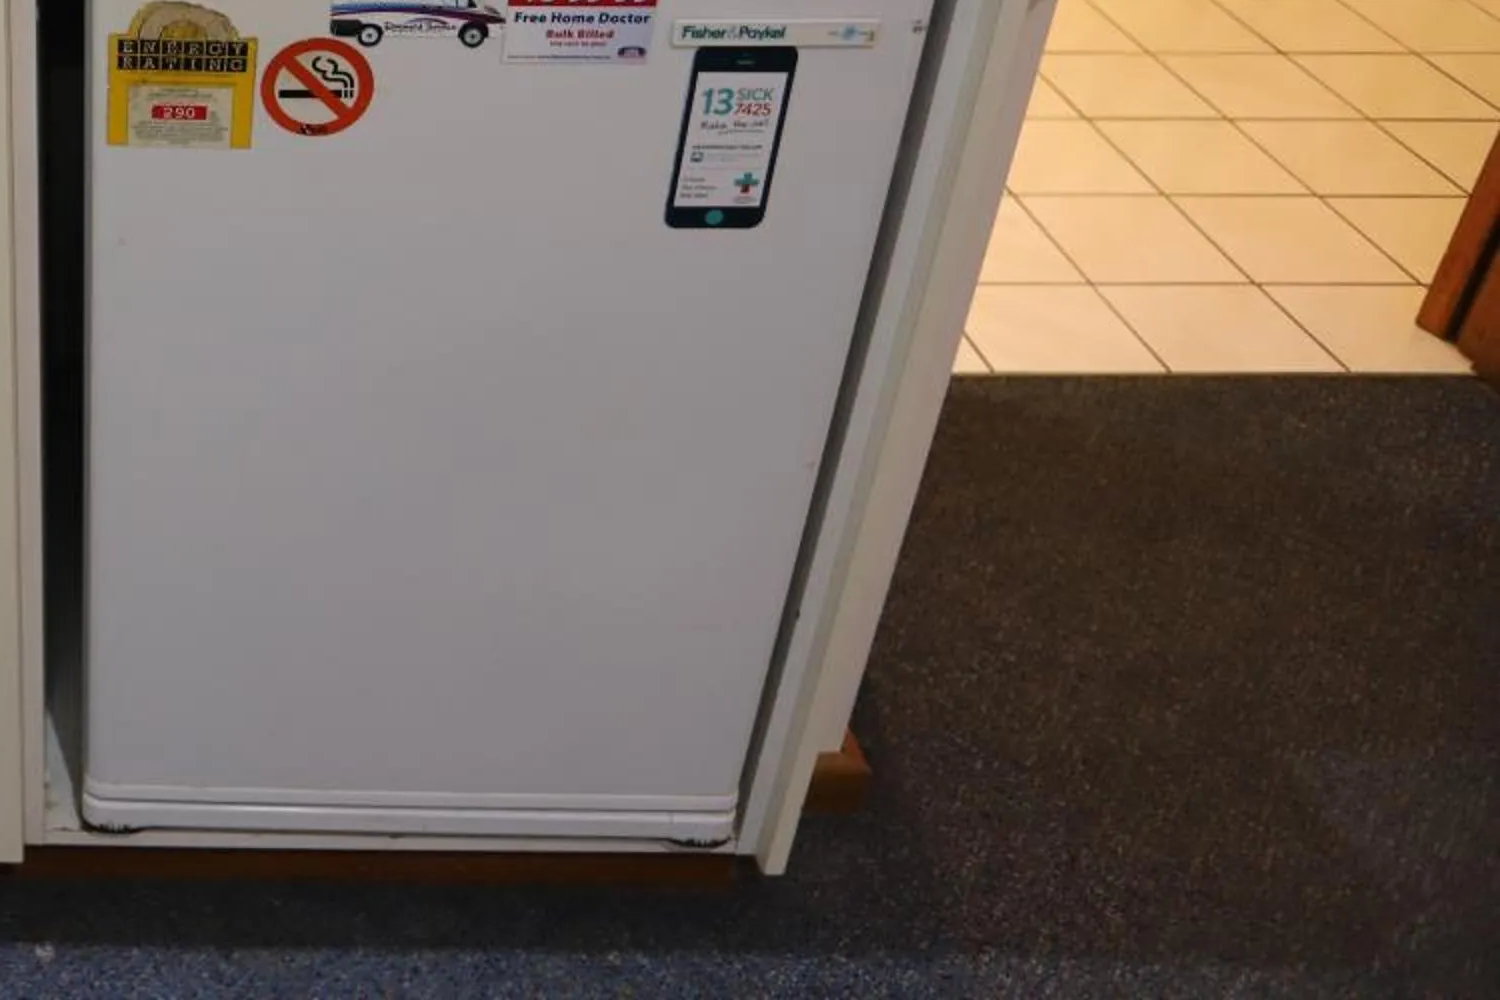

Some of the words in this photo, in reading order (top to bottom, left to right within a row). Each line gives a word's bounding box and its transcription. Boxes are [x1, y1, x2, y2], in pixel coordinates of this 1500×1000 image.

[514, 12, 547, 24] Free
[551, 12, 595, 24] Home
[599, 12, 651, 24] Doctor
[682, 25, 726, 39] Fisher
[739, 25, 786, 41] Paykel
[122, 40, 244, 57] ENERGY
[122, 56, 244, 71] RATING
[703, 87, 734, 115] 13
[737, 87, 774, 101] SICK
